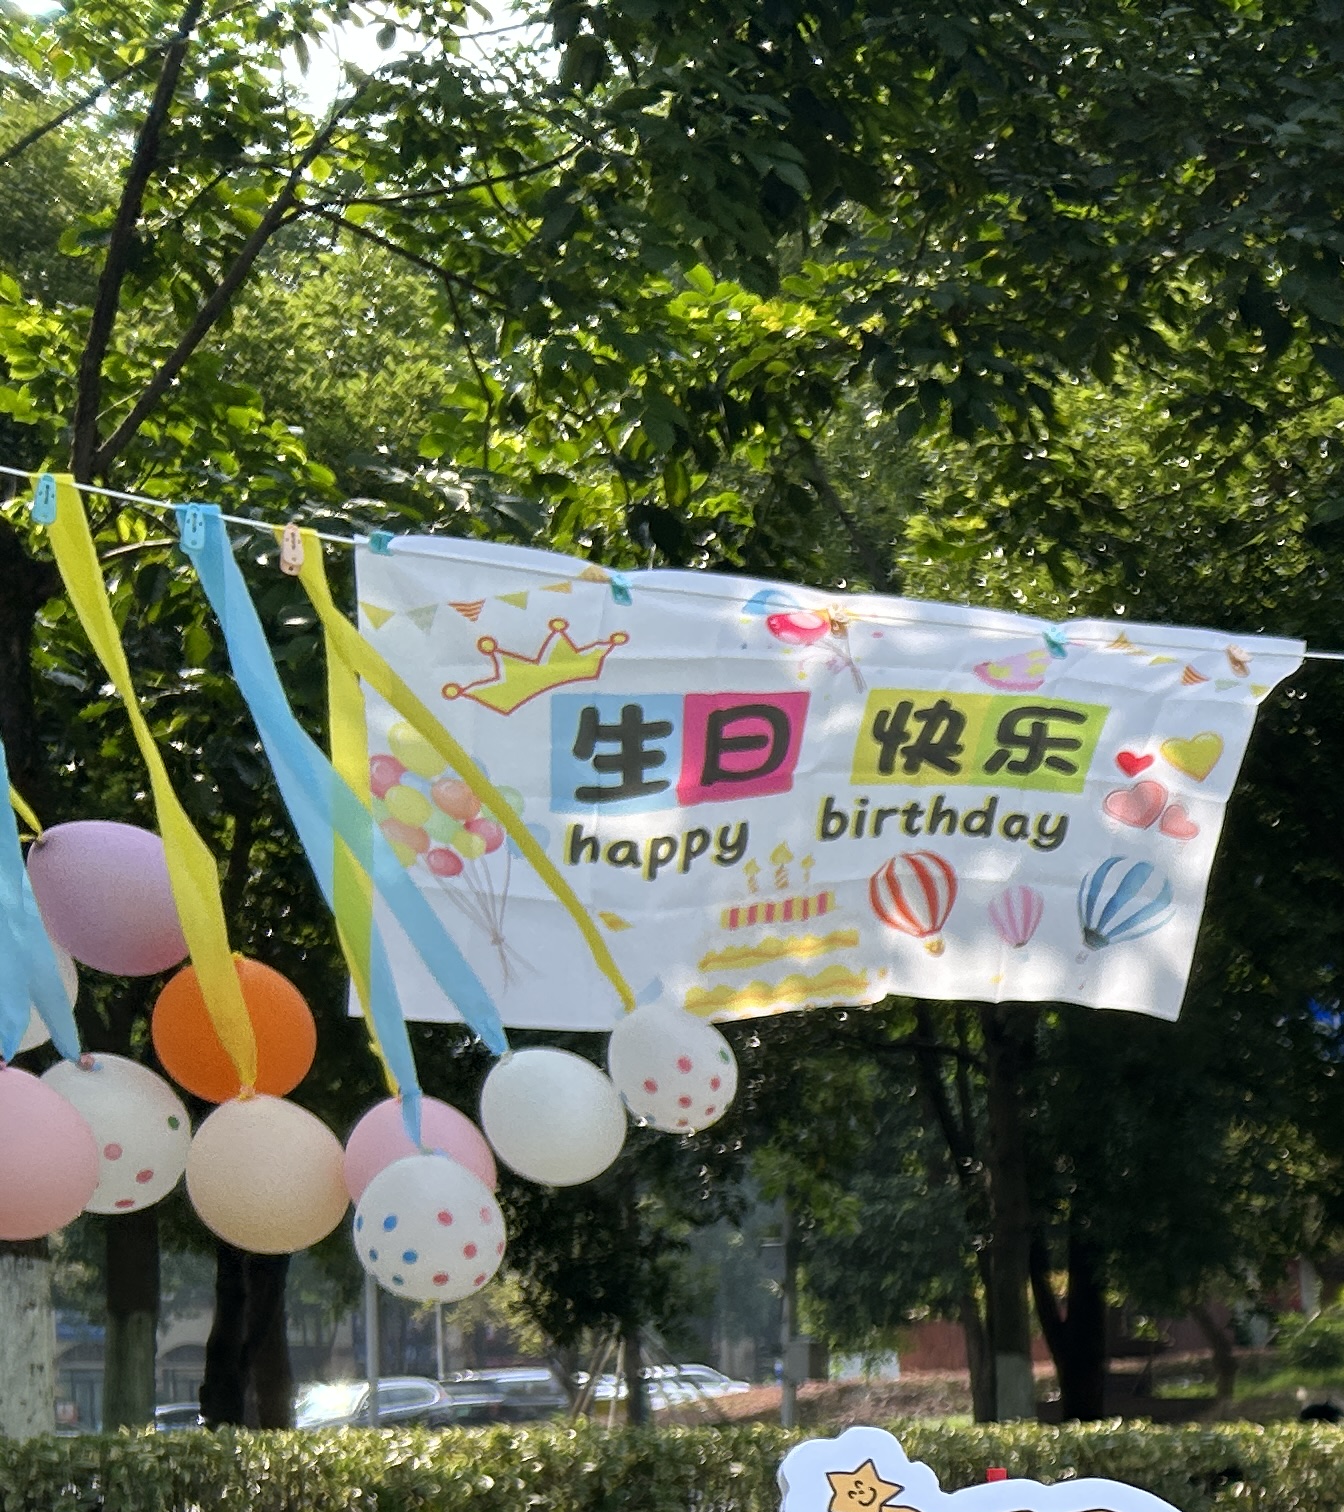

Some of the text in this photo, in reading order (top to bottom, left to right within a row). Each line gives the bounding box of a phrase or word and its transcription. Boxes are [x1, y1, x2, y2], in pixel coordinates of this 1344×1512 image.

[572, 698, 1090, 806] 生日快乐
[563, 795, 1071, 881] happy birthday
